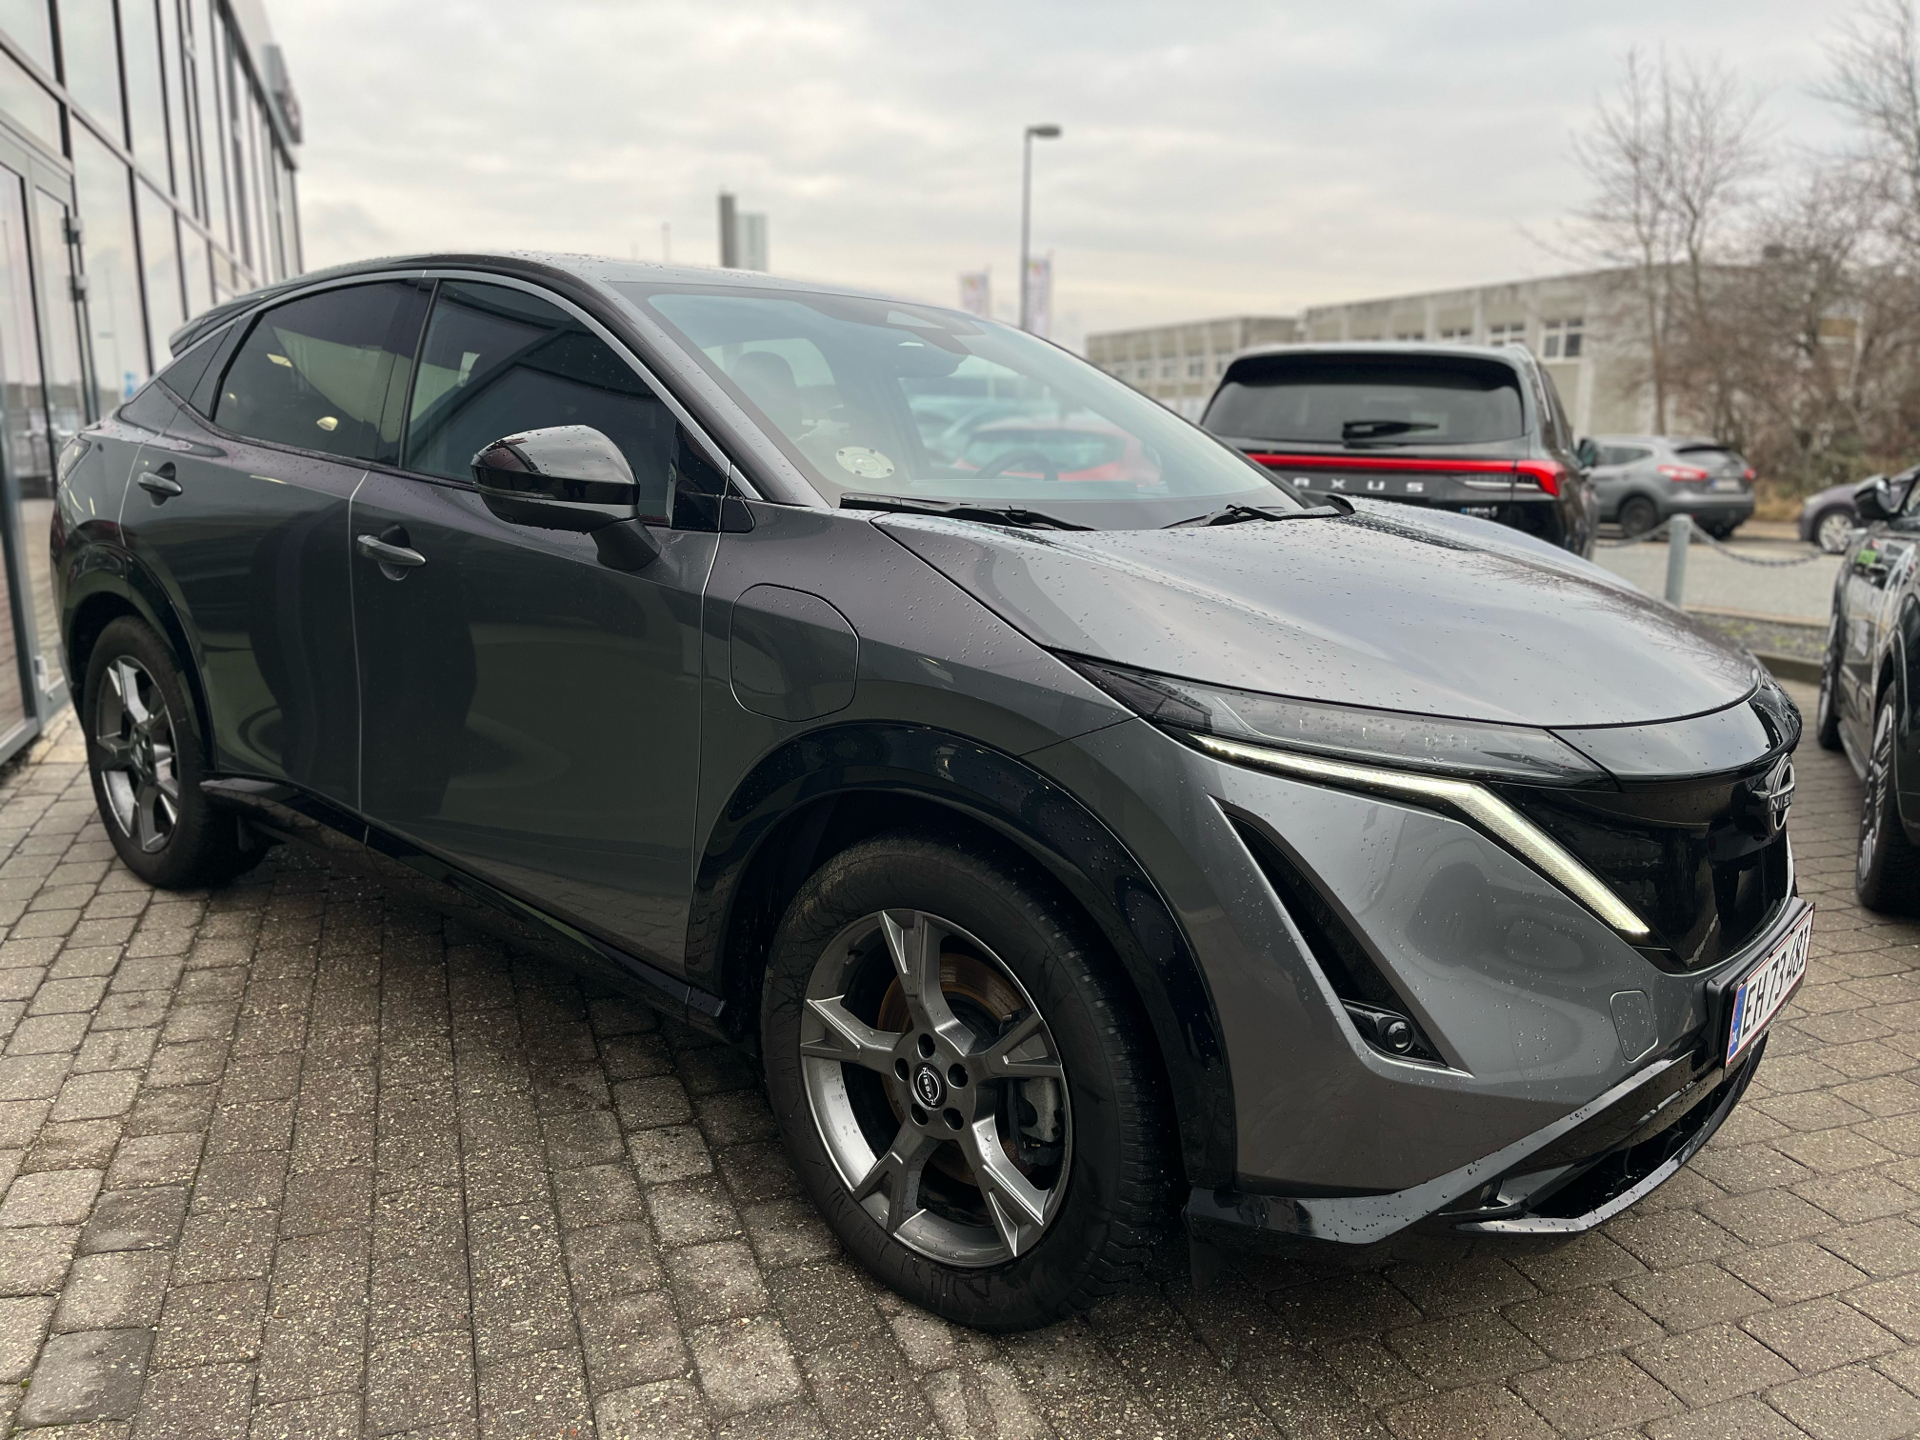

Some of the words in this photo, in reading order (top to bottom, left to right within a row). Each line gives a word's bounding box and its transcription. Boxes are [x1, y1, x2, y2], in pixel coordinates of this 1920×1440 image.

[1292, 477, 1425, 493] AXUS
[1770, 791, 1794, 811] NIS
[1741, 970, 1769, 1038] EH
[1766, 950, 1787, 1011] 73
[1786, 924, 1809, 983] 481
[922, 1066, 937, 1106] NISSAN
